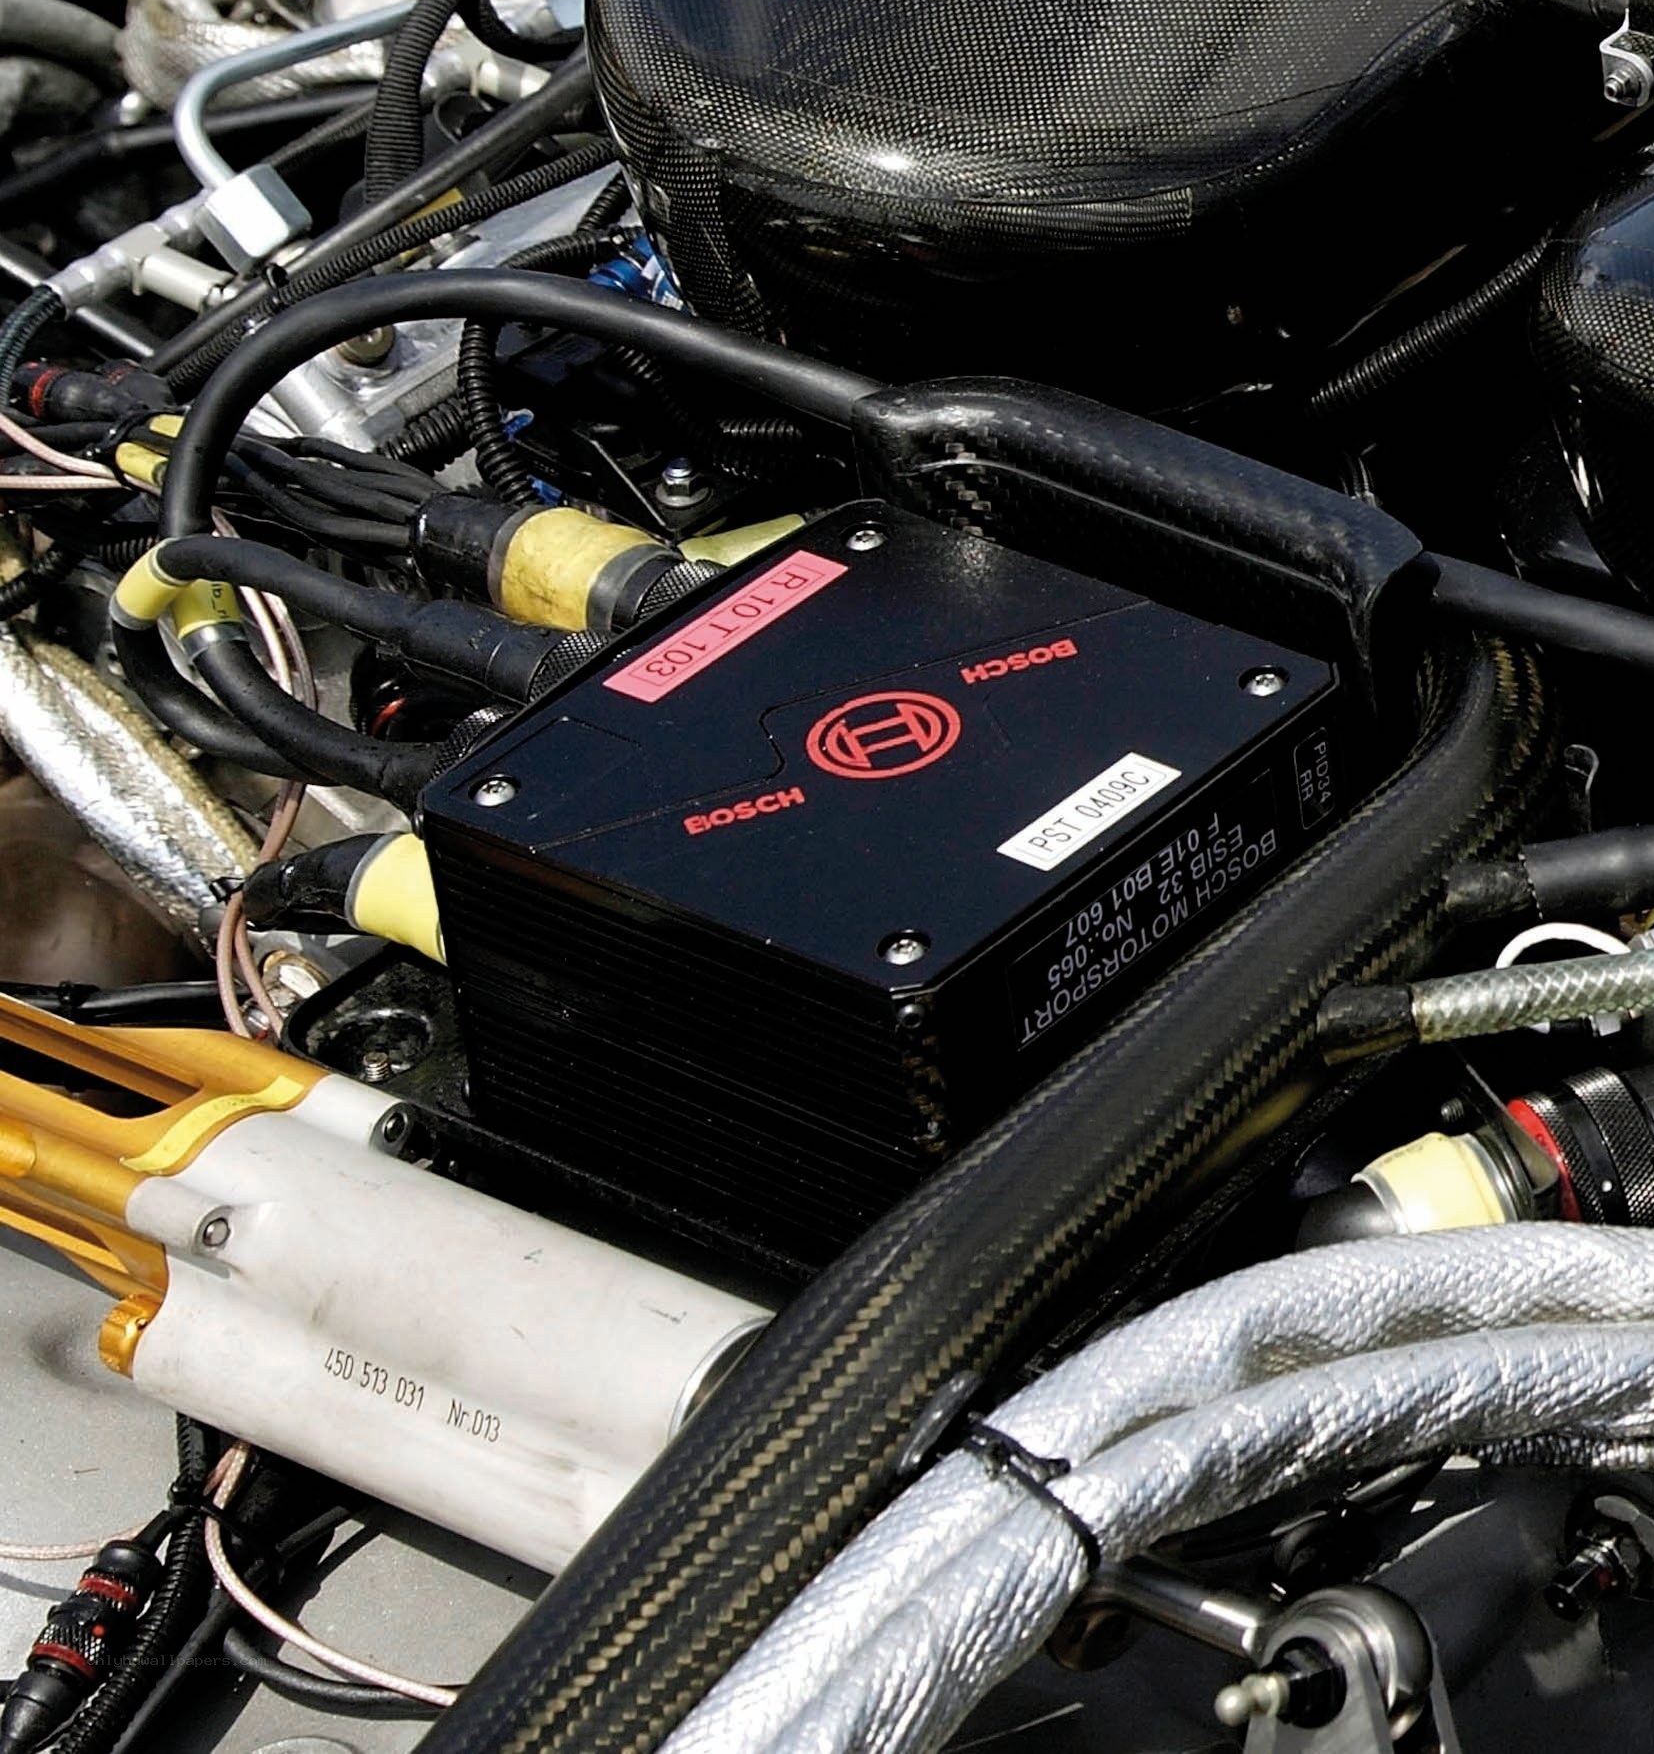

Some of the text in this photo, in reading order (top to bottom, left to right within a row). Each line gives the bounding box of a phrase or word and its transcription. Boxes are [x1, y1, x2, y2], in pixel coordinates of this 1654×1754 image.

[772, 571, 808, 591] R
[708, 622, 741, 639] T
[645, 640, 707, 678] 103
[959, 638, 1079, 686] BOSCH
[682, 786, 807, 836] BOSCH
[1028, 769, 1152, 854] PST 0409C
[1206, 811, 1221, 840] F
[1189, 823, 1243, 880] ESIB
[1157, 869, 1185, 905] 32
[1020, 828, 1277, 1044] BOSCH MOTORSPORT
[1065, 901, 1104, 948] 607
[324, 1347, 501, 1443] 450 513 031 Nr.013
